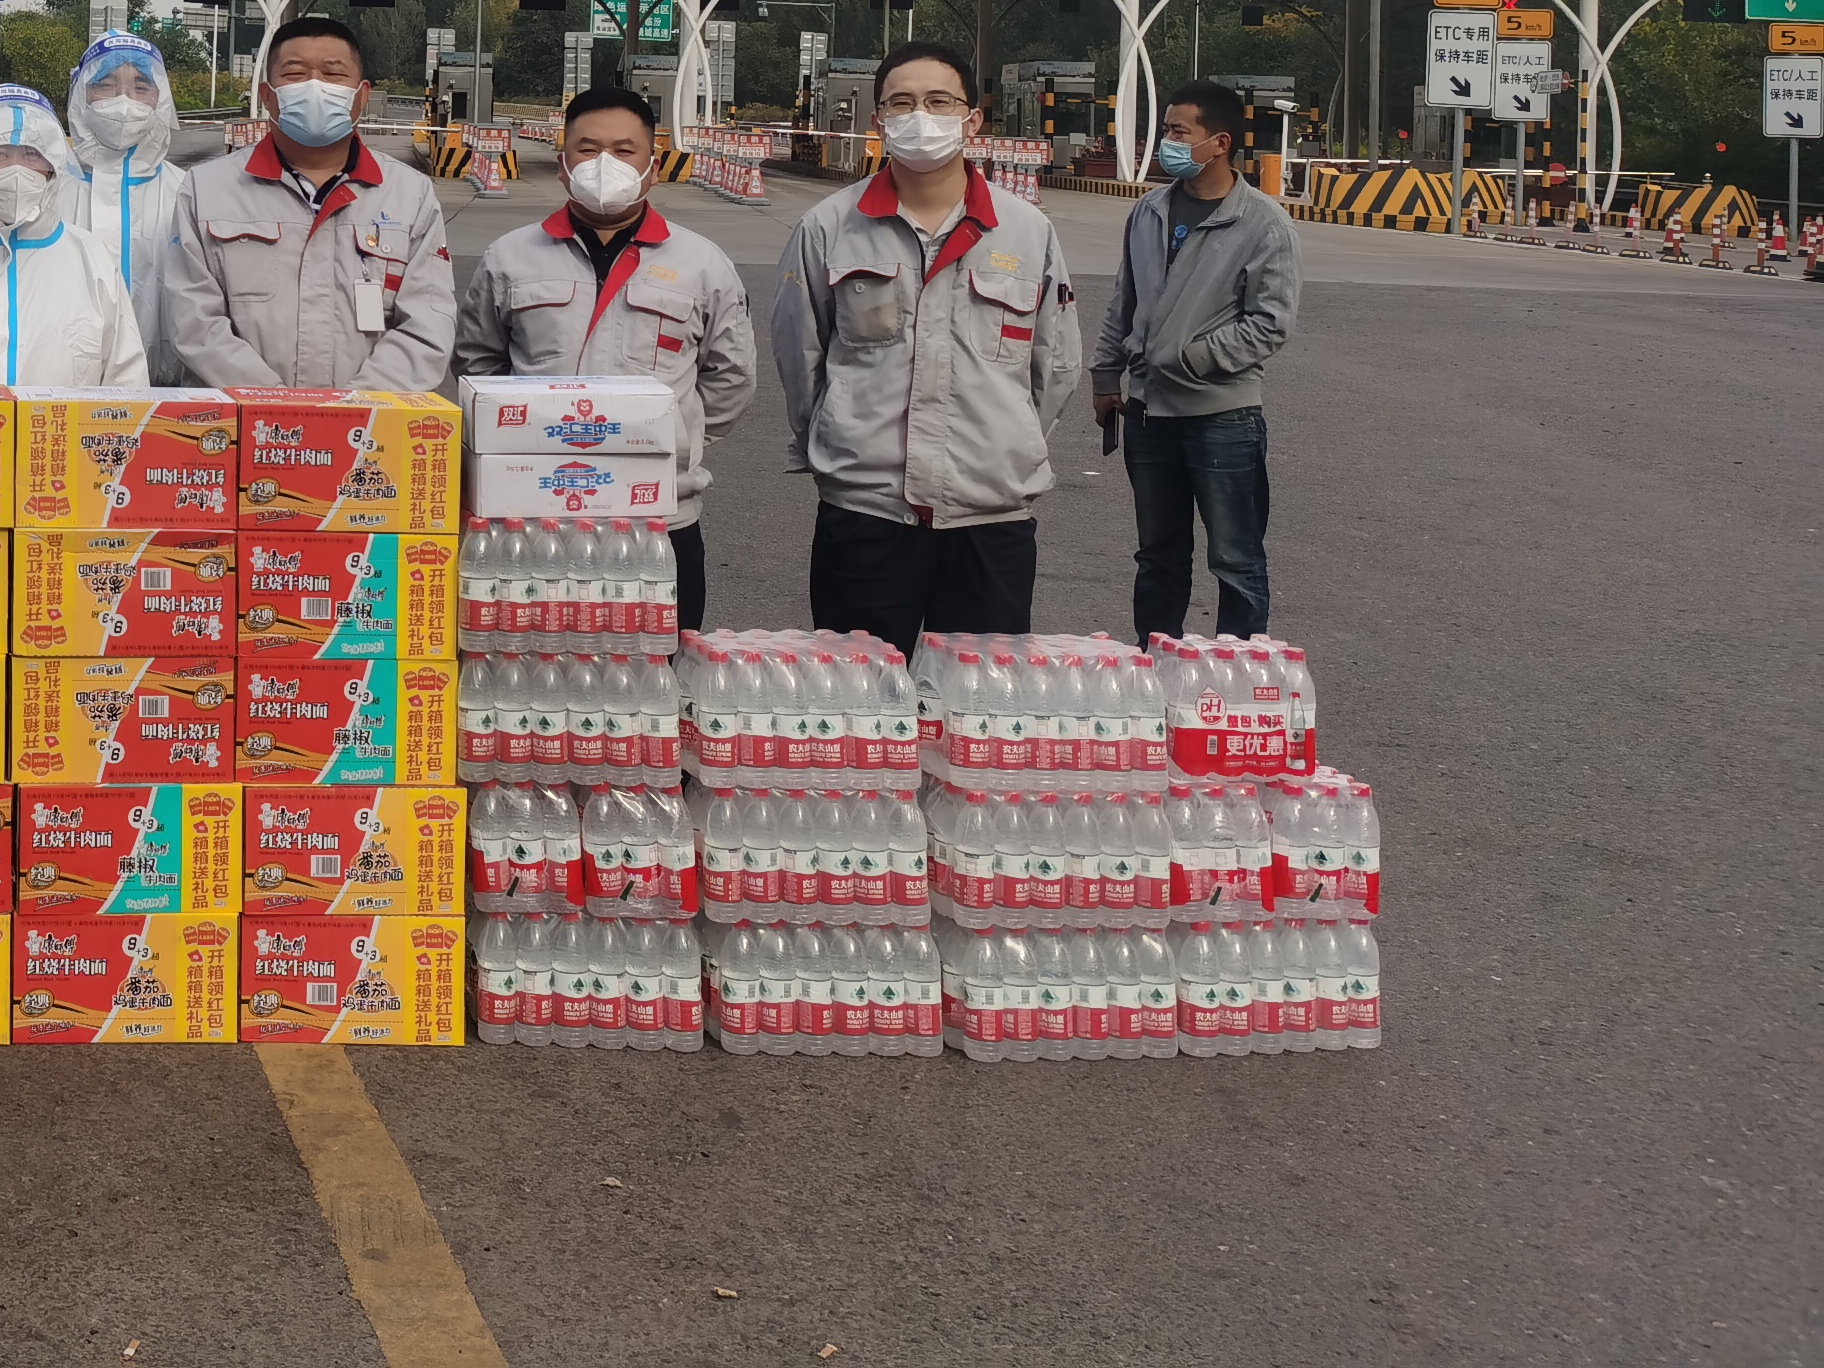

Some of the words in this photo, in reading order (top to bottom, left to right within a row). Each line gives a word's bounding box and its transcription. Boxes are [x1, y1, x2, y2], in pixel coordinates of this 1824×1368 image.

[1507, 16, 1522, 30] 5
[1434, 26, 1490, 42] ETC专用
[1781, 31, 1796, 46] 5
[1435, 49, 1489, 64] 保持车距
[1501, 56, 1545, 66] ETC/人工
[1499, 73, 1539, 85] 保持车
[1770, 69, 1819, 82] ETC/人工
[1770, 89, 1819, 101] 保持车距
[501, 406, 524, 422] 双汇
[543, 422, 622, 438] 双汇王中王
[30, 415, 47, 493] 开箱领红包
[254, 448, 332, 466] 红烧牛肉面
[145, 468, 224, 485] 红烧牛肉面
[352, 469, 383, 487] 番茄
[430, 443, 448, 519] 开箱领红包
[410, 459, 427, 529] 箱箱送礼品
[47, 533, 63, 605] 箱箱送礼品
[26, 543, 43, 622] 开箱领红包
[251, 573, 330, 592] 红烧牛肉面
[143, 595, 222, 612] 红烧牛肉面
[428, 568, 445, 646] 开箱领红包
[44, 661, 61, 732] 箱箱送礼品
[23, 671, 40, 749] 开箱领红包
[249, 701, 328, 719] 红烧牛肉面
[1200, 698, 1221, 716] pH
[141, 723, 219, 739] 红烧牛肉面
[335, 729, 371, 747] 藤椒
[359, 746, 391, 757] 牛肉面
[407, 710, 423, 781] 箱箱送礼品
[1226, 735, 1284, 756] 更优惠
[33, 831, 112, 848] 红烧牛肉面
[260, 833, 339, 849] 红烧牛肉面
[438, 823, 454, 902] 开箱领红包
[418, 840, 434, 912] 箱箱送礼品
[27, 959, 107, 975] 红烧牛肉面
[256, 959, 335, 977] 红烧牛肉面
[207, 949, 224, 1028] 开箱领红包
[435, 952, 453, 1032] 开箱领红包
[187, 966, 203, 1038] 箱箱送礼品
